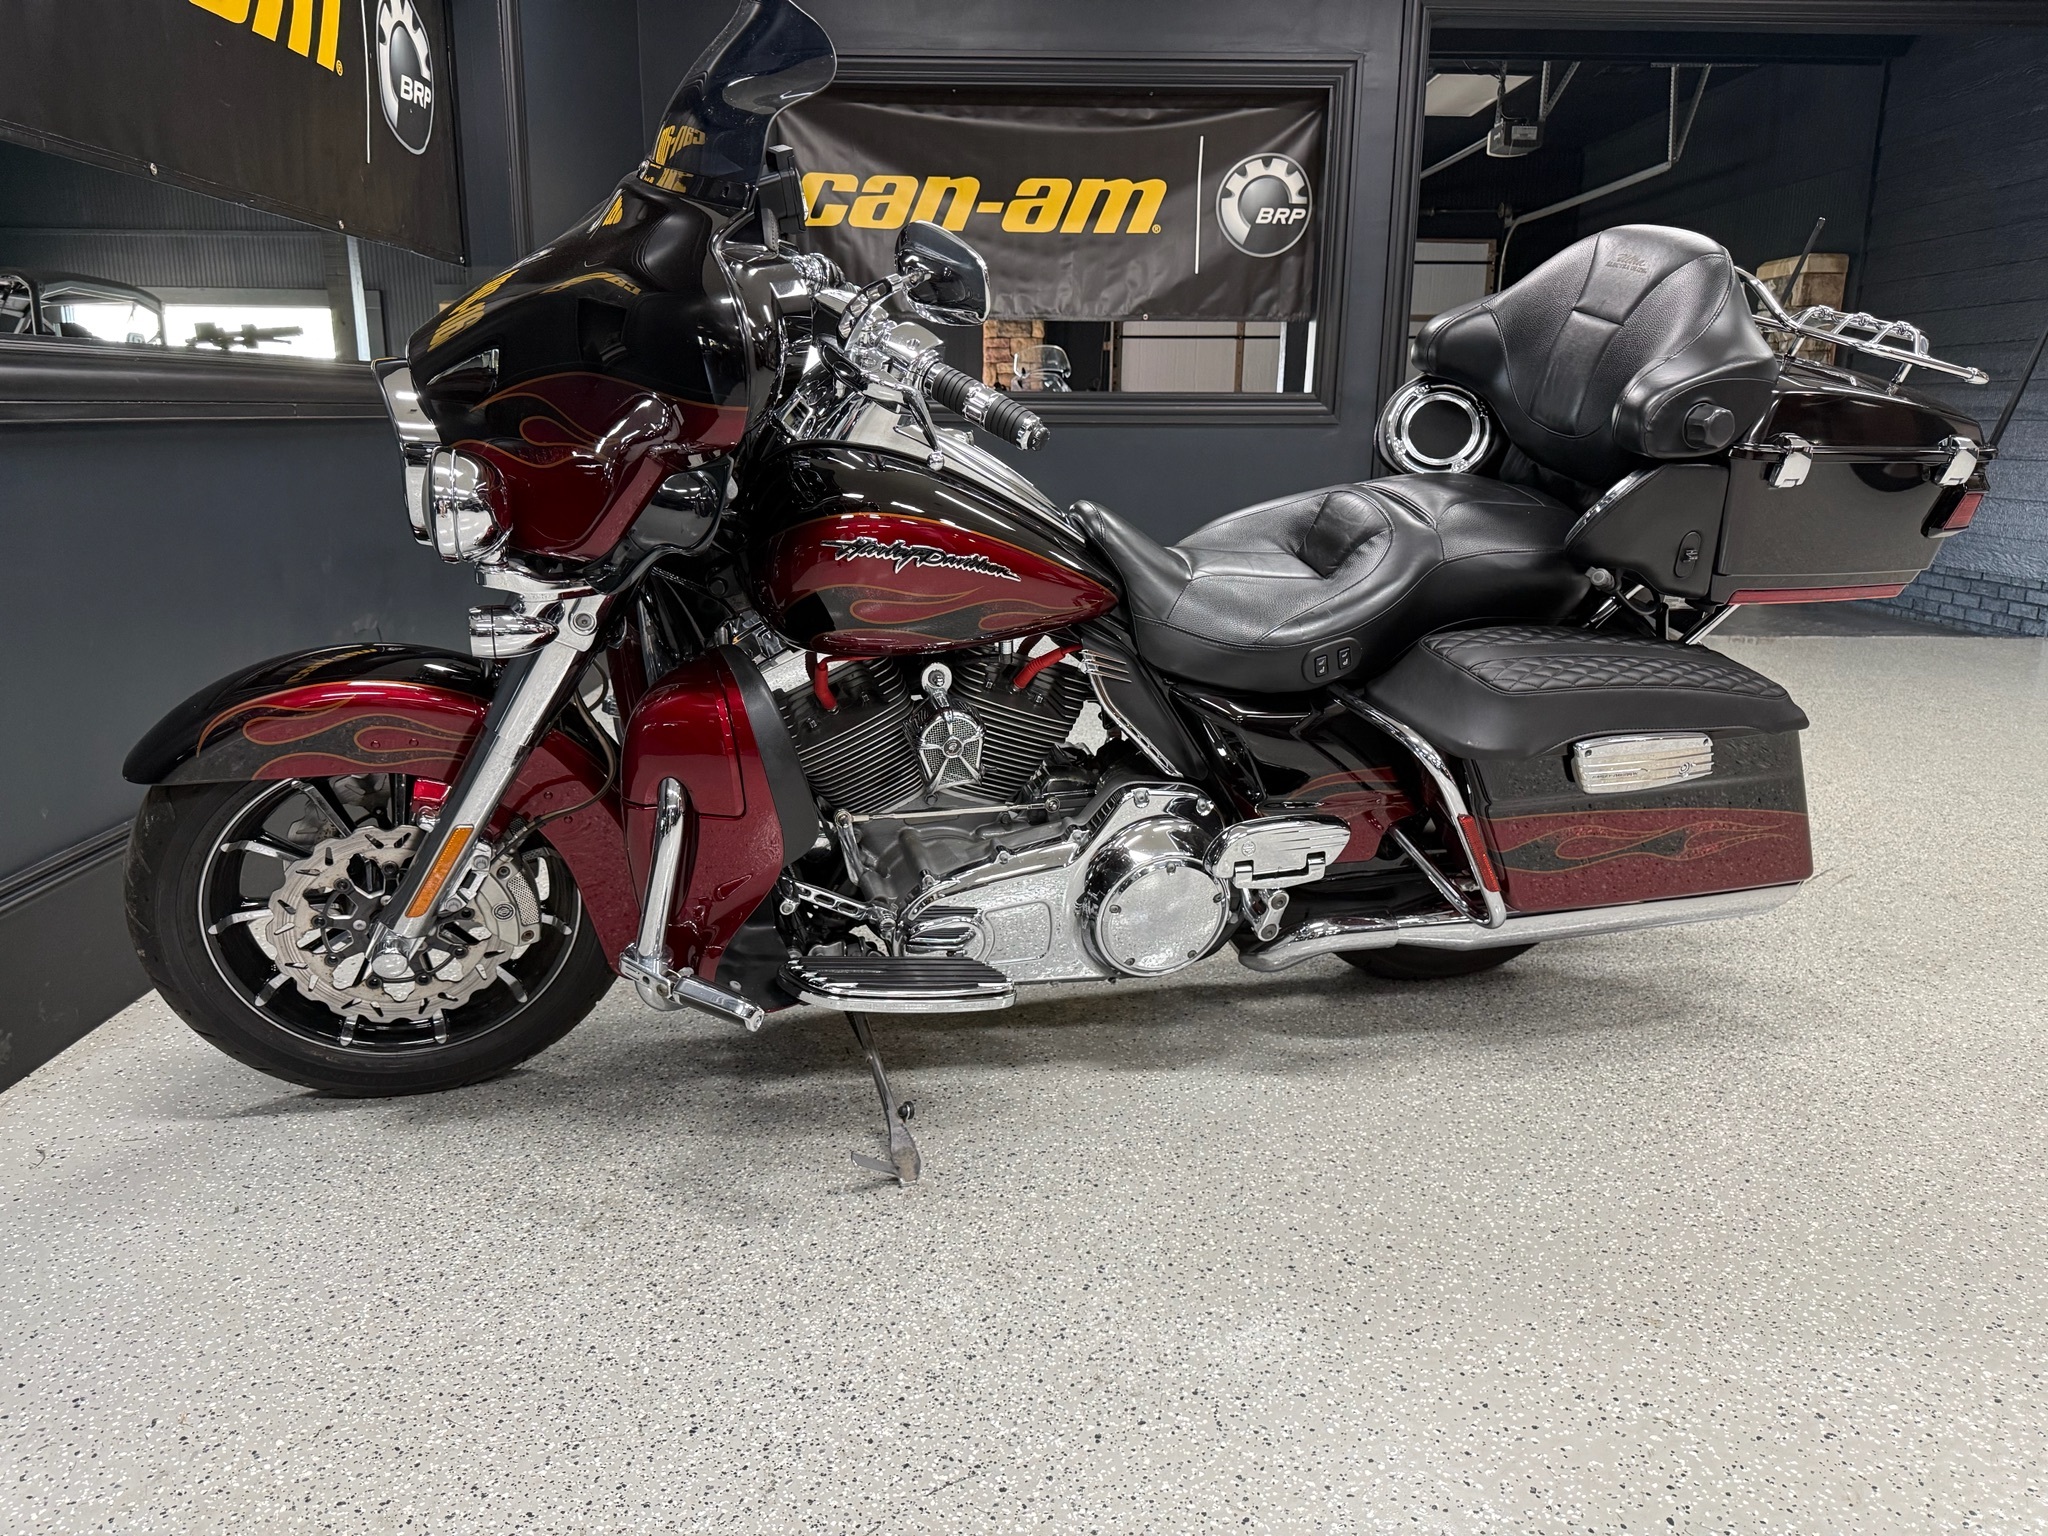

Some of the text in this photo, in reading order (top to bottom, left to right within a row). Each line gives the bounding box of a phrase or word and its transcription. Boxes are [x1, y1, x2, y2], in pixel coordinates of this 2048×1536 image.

[400, 73, 432, 109] BRP
[801, 172, 1168, 234] can-am
[1255, 207, 1307, 225] BRP
